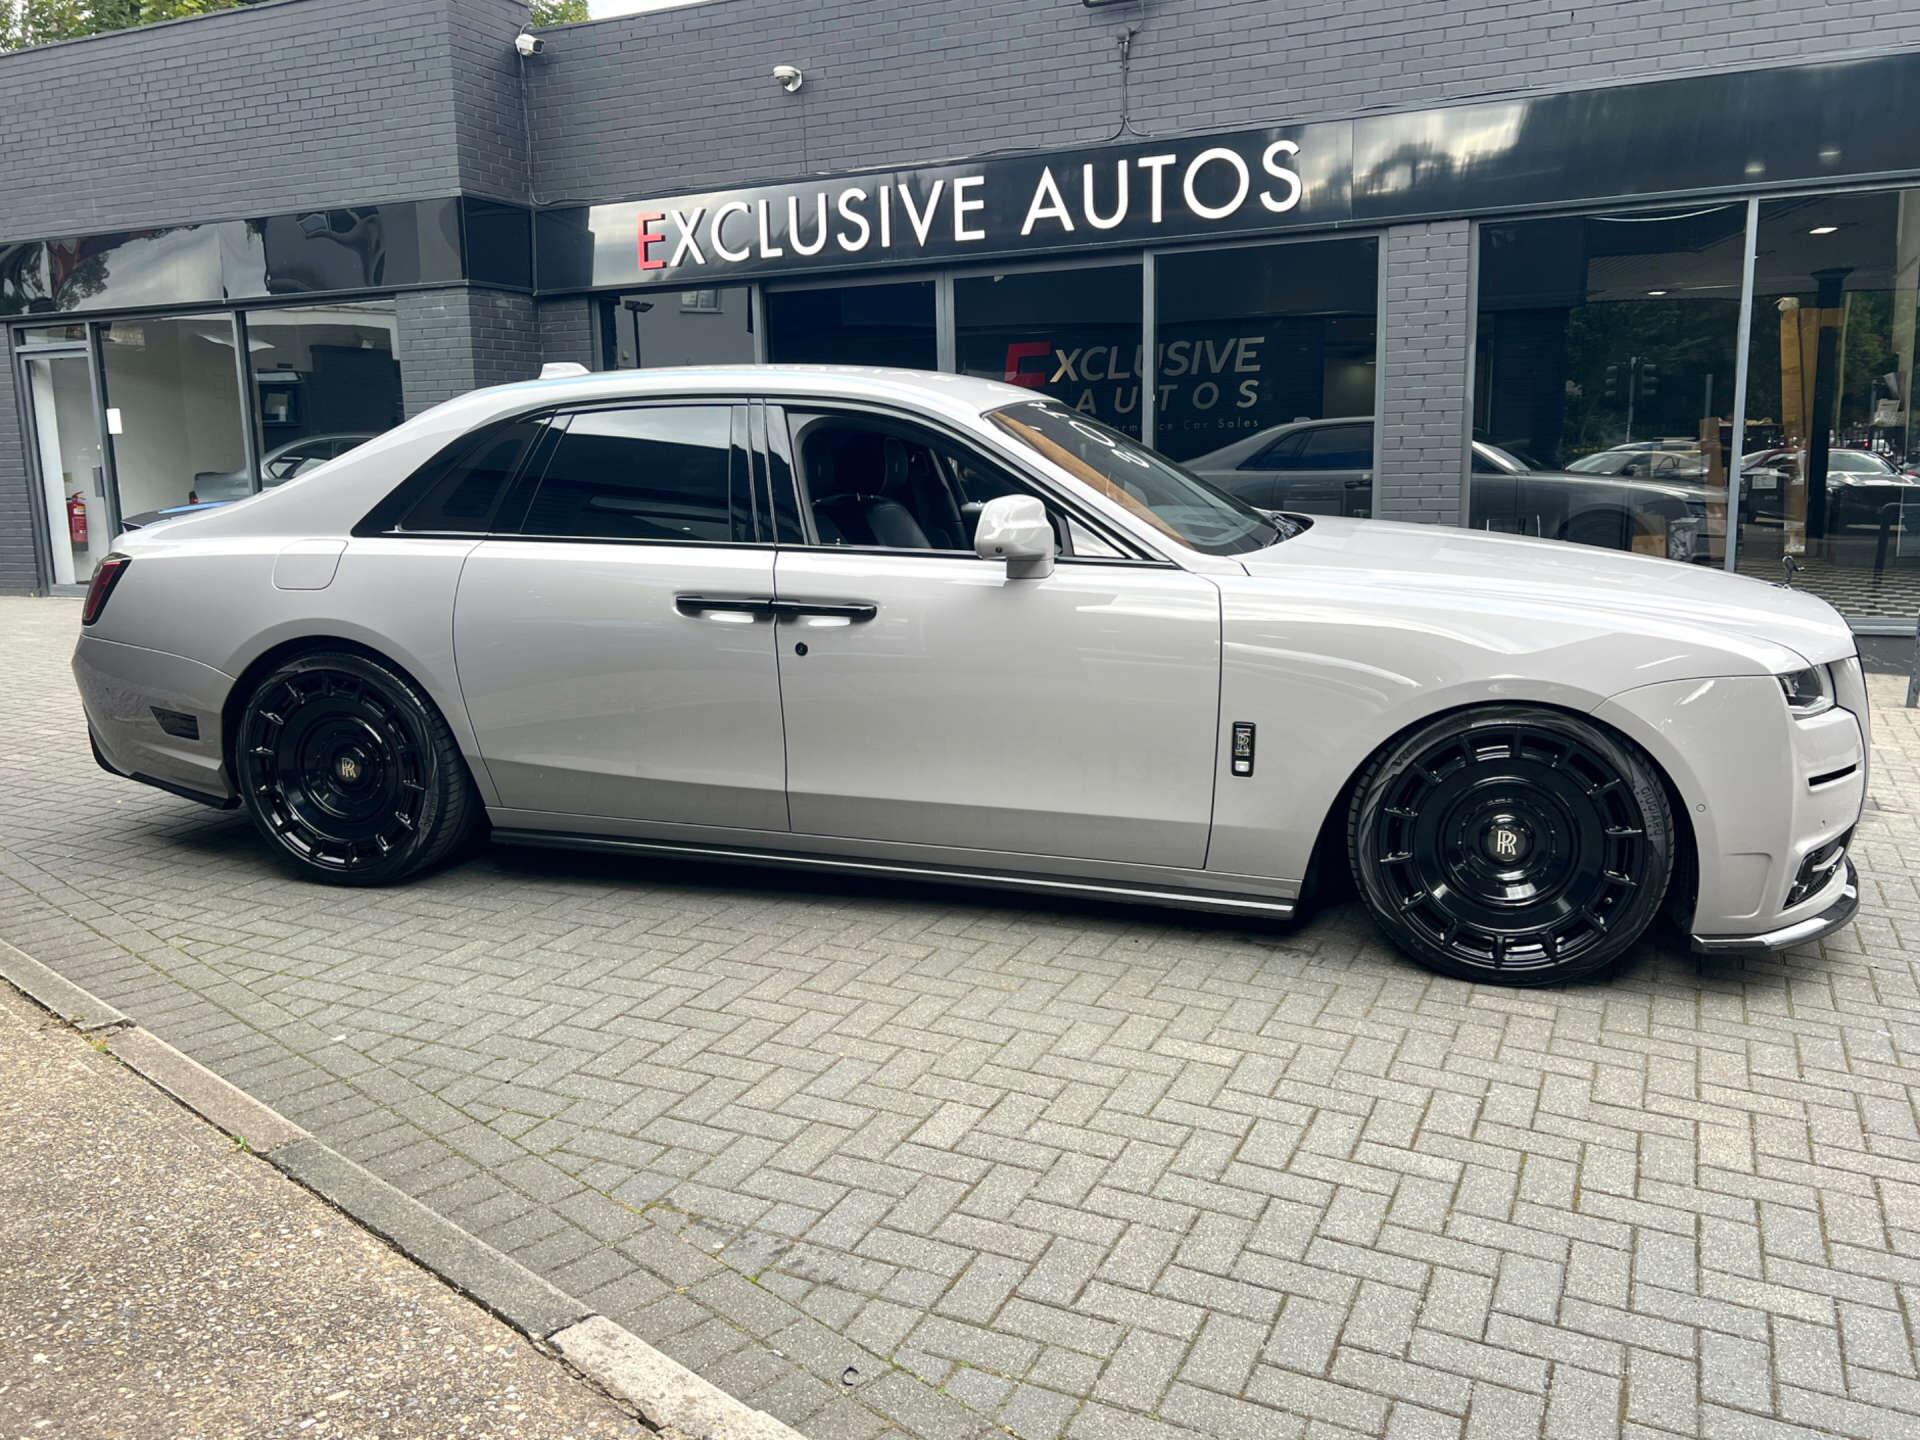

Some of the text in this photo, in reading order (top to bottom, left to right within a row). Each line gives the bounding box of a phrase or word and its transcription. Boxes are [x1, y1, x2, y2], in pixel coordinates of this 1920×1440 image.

[637, 140, 1303, 271] EXCLUSIVE AUTOS
[1004, 336, 1265, 388] EXCLUSIVE
[1075, 379, 1260, 415] AUTOS
[1217, 416, 1259, 429] Sales
[1497, 830, 1517, 855] RR
